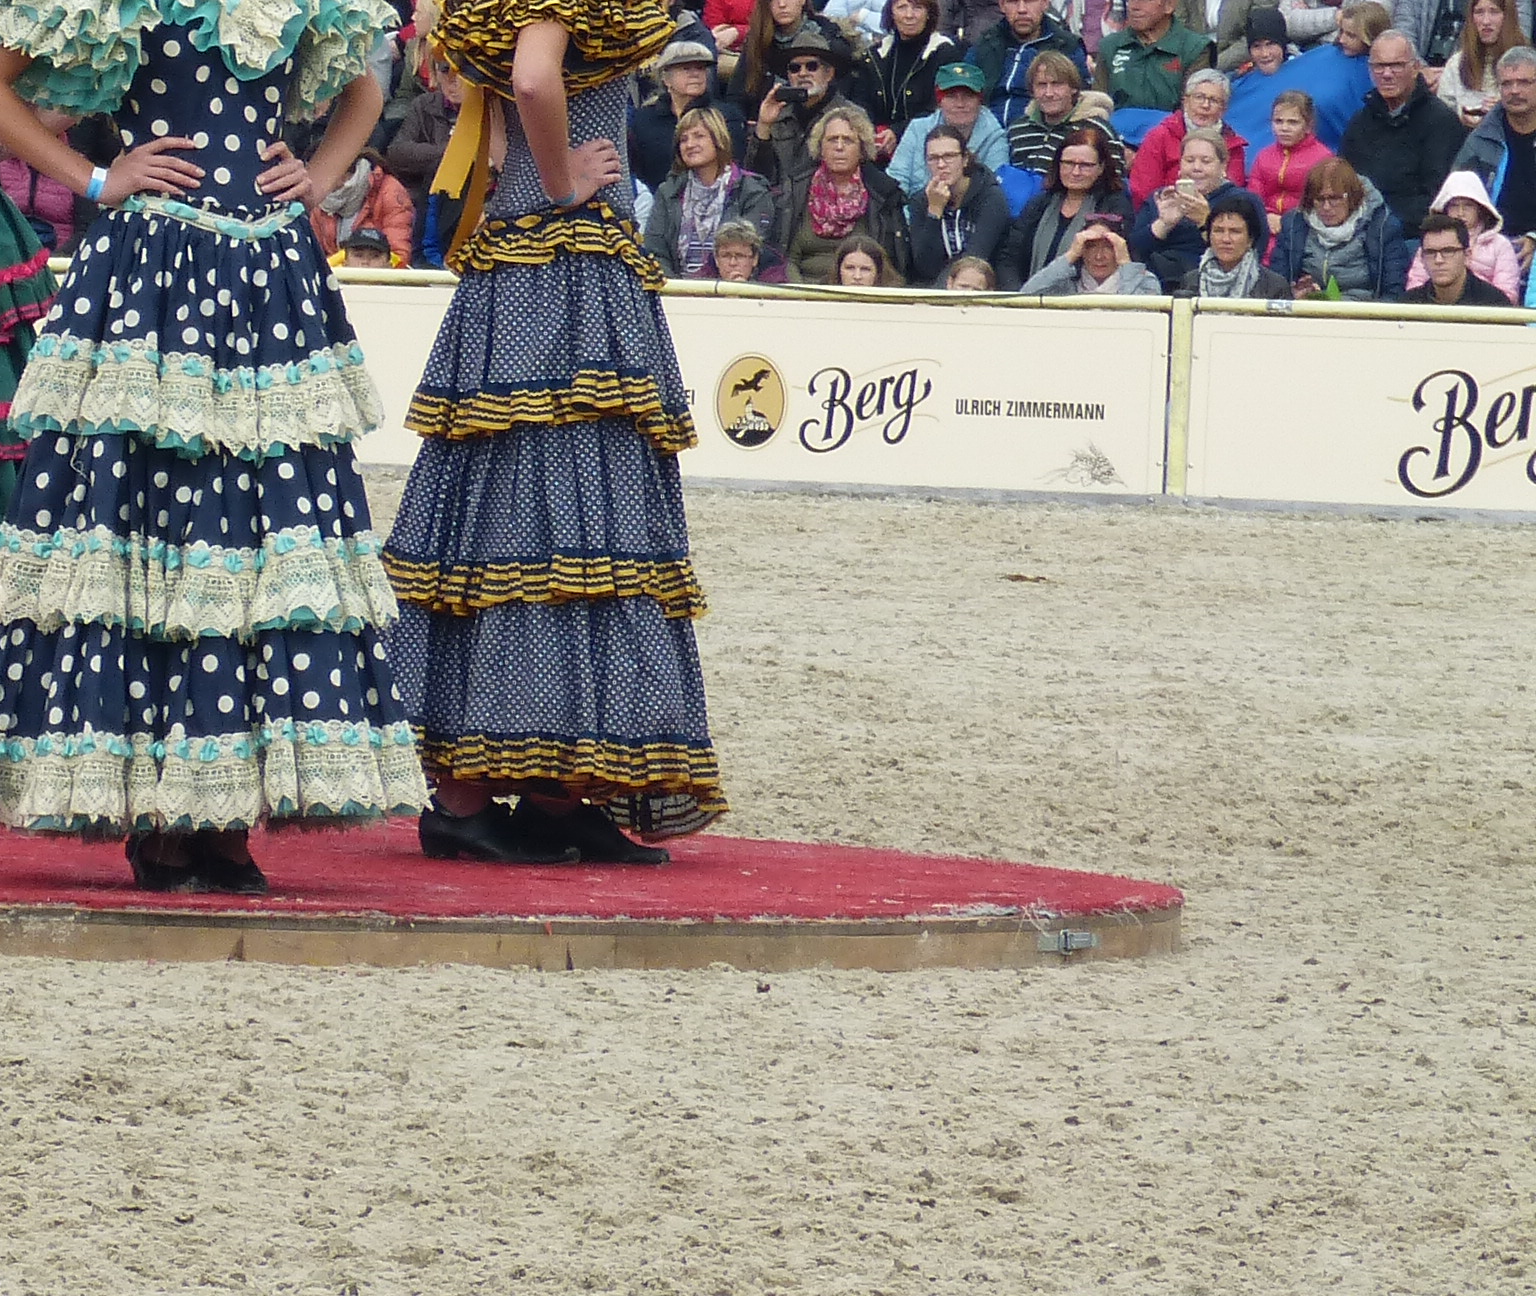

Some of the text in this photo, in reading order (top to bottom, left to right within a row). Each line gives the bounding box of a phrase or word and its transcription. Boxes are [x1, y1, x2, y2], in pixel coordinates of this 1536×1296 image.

[798, 367, 933, 454] Berg
[955, 398, 1002, 416] ULRICH
[1006, 400, 1106, 421] ZIMMERMANN
[1397, 369, 1536, 499] Ber
